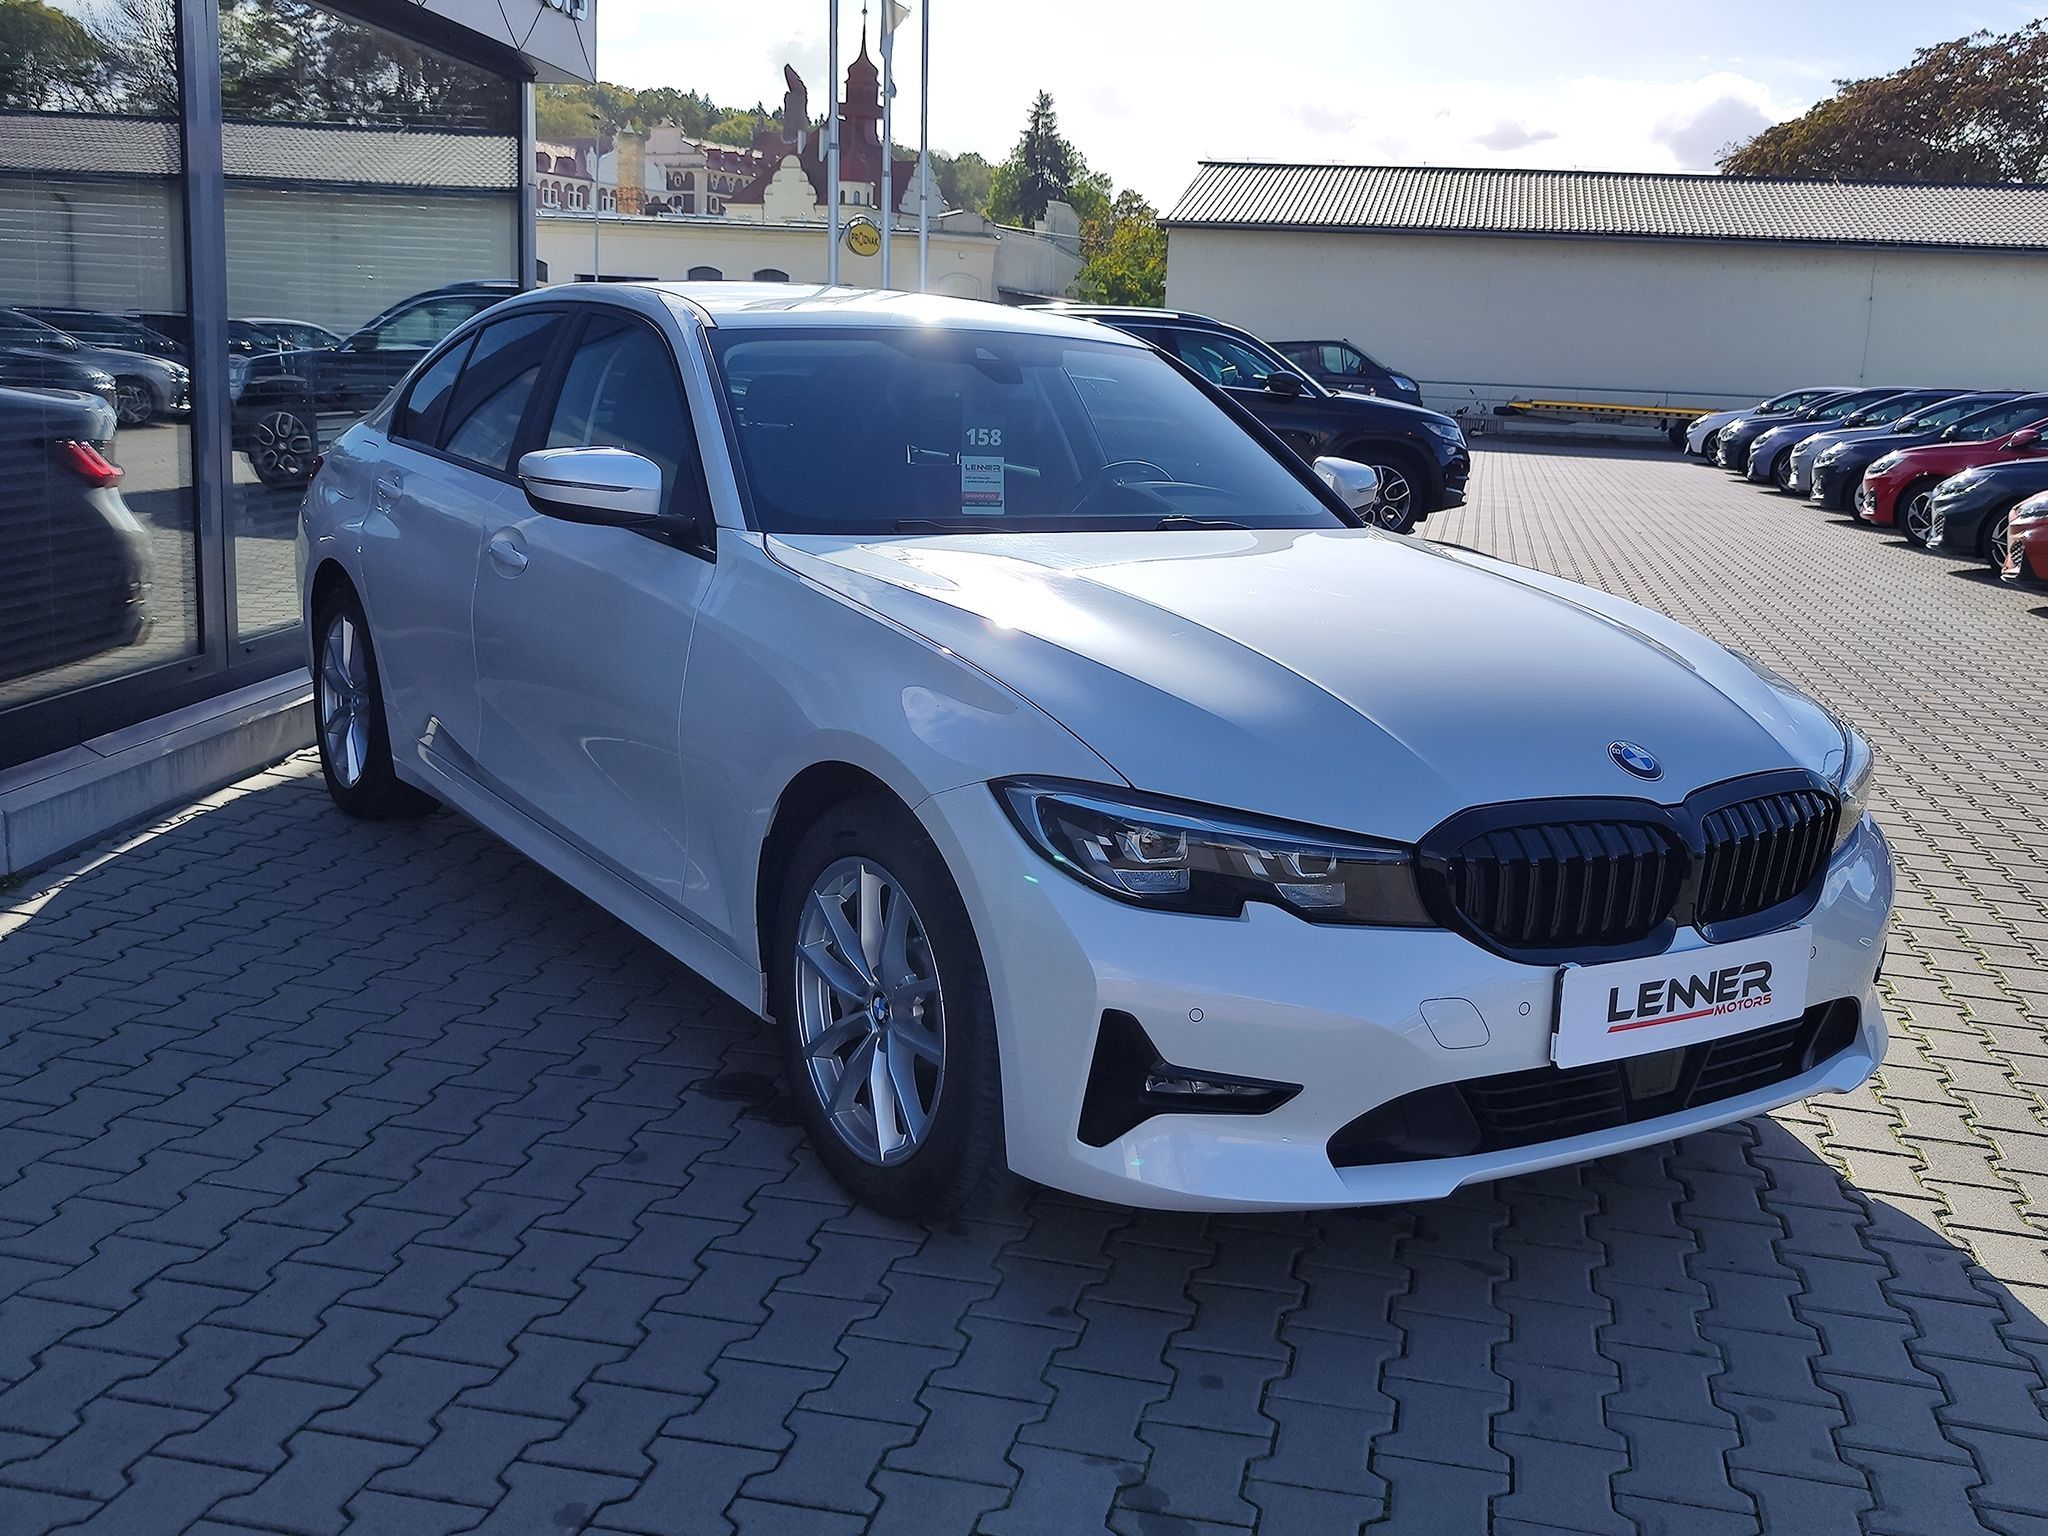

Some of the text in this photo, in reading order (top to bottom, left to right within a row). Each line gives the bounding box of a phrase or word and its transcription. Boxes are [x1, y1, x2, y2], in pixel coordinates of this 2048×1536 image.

[966, 428, 1002, 446] 158
[965, 464, 1001, 473] LENNER
[1607, 960, 1773, 1023] LENNER
[1713, 993, 1772, 1016] MOTORS
